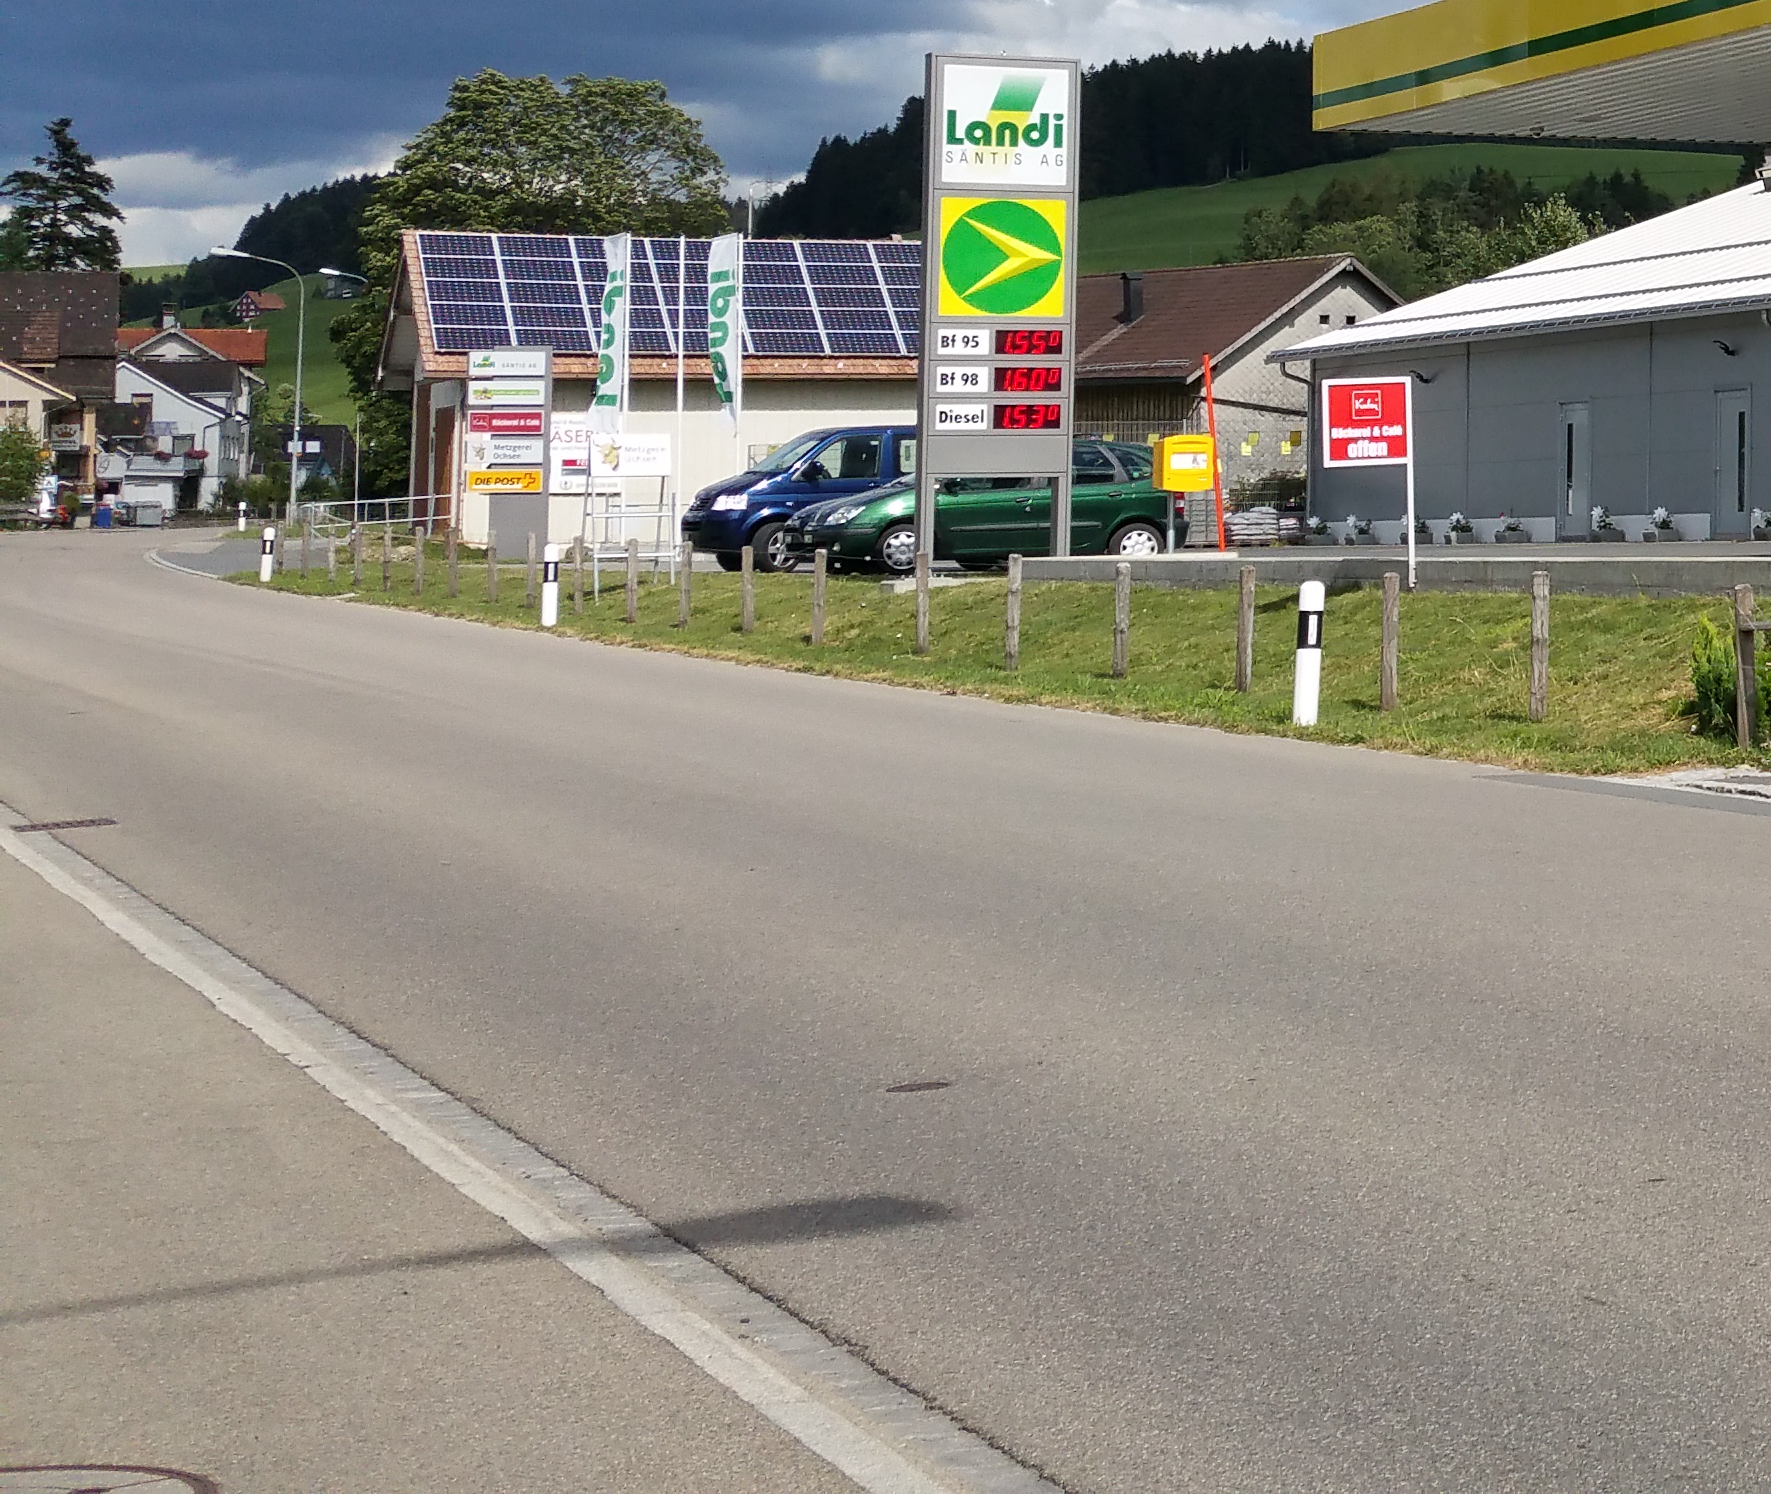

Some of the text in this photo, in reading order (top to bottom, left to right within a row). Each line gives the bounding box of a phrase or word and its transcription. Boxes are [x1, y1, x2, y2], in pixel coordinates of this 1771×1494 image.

[946, 109, 1064, 148] Landi
[945, 149, 1064, 166] SÄNTIS AG
[710, 269, 736, 403] Landi
[940, 334, 979, 348] Bf 95
[940, 372, 979, 386] Bf 98
[939, 409, 985, 424] Diesel
[493, 444, 532, 452] Metzgerei
[1347, 440, 1388, 458] offen
[493, 452, 521, 460] Ochsen
[474, 476, 522, 486] DIE POST
